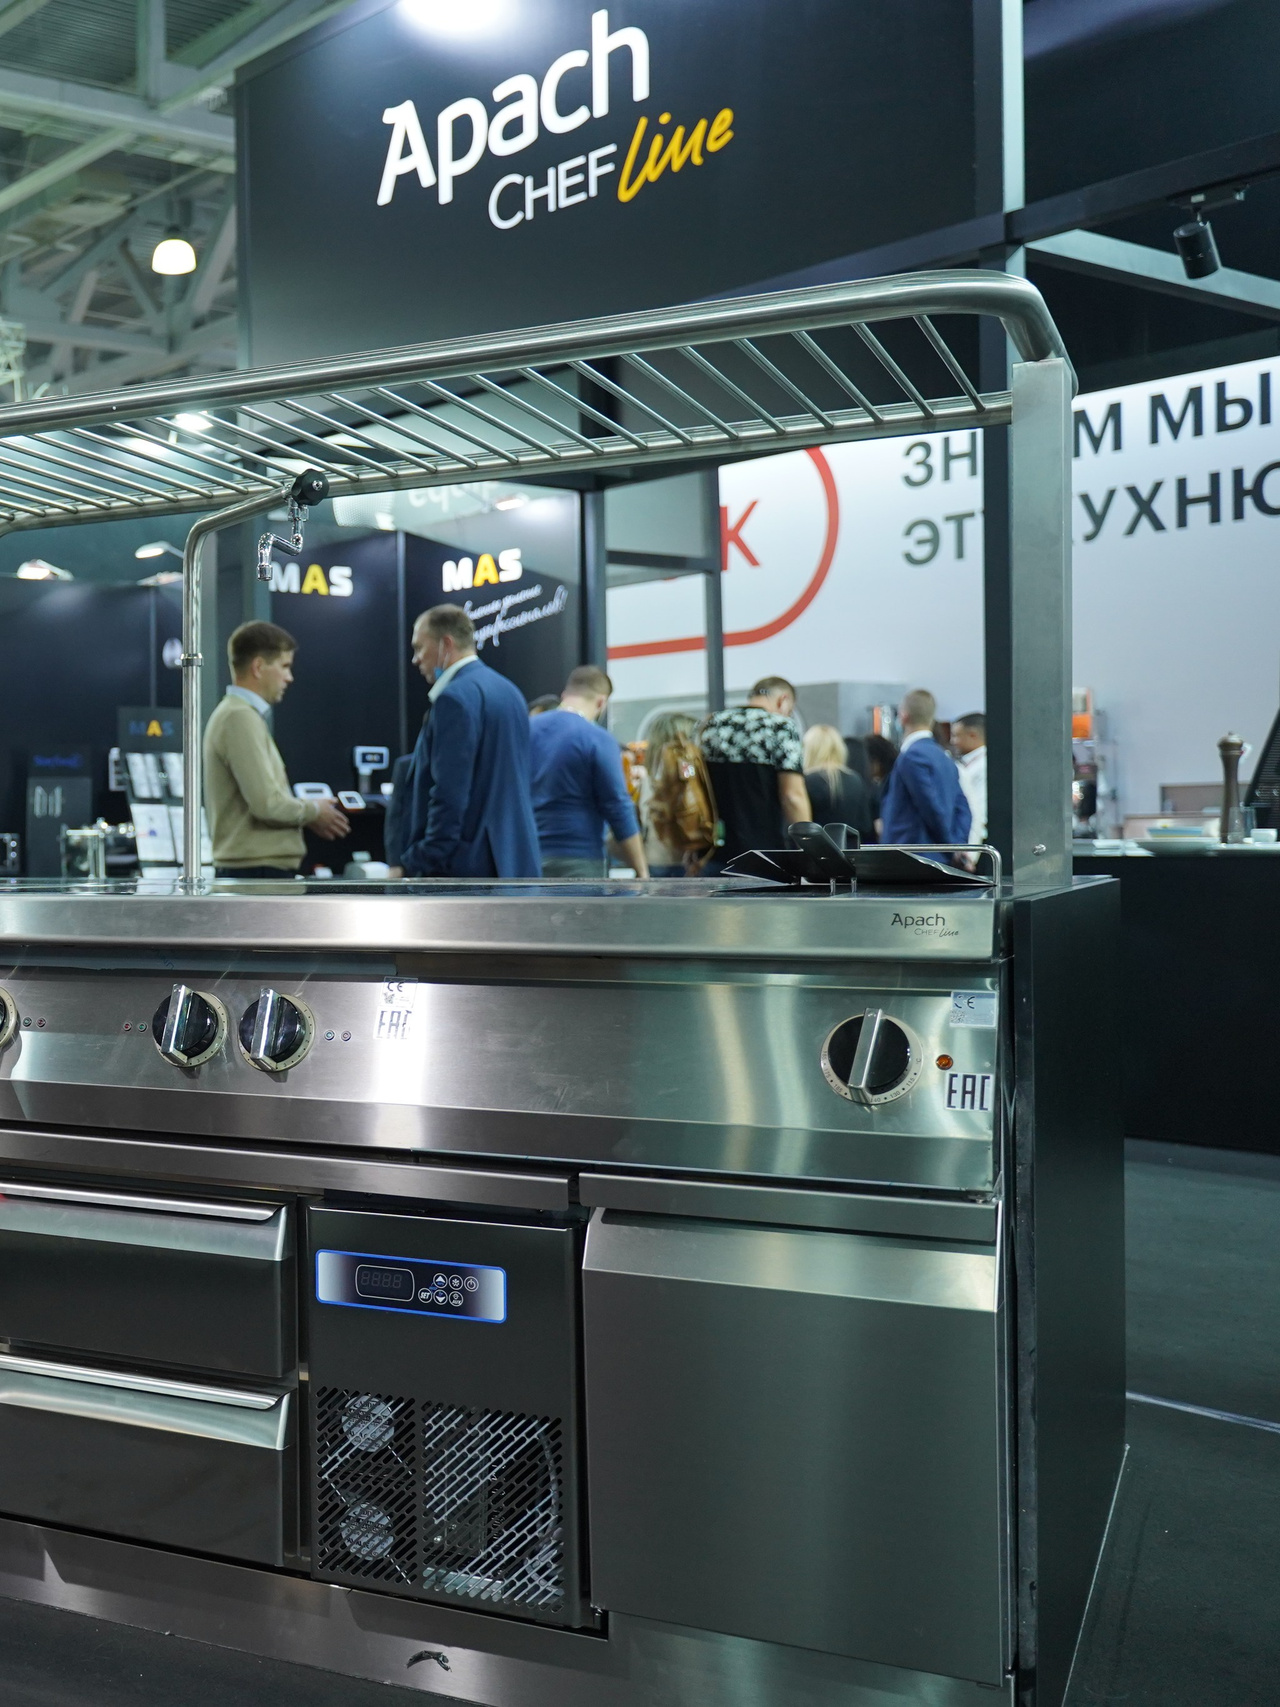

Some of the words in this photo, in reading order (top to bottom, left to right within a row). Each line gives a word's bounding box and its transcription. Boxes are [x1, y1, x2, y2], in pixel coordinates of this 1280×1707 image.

[376, 8, 650, 206] Apach
[488, 142, 618, 230] CHEF
[1149, 371, 1272, 445] МЫ
[268, 561, 354, 597] MAS
[442, 547, 523, 592] MAS
[890, 912, 946, 929] Apach
[420, 1291, 431, 1300] SET
